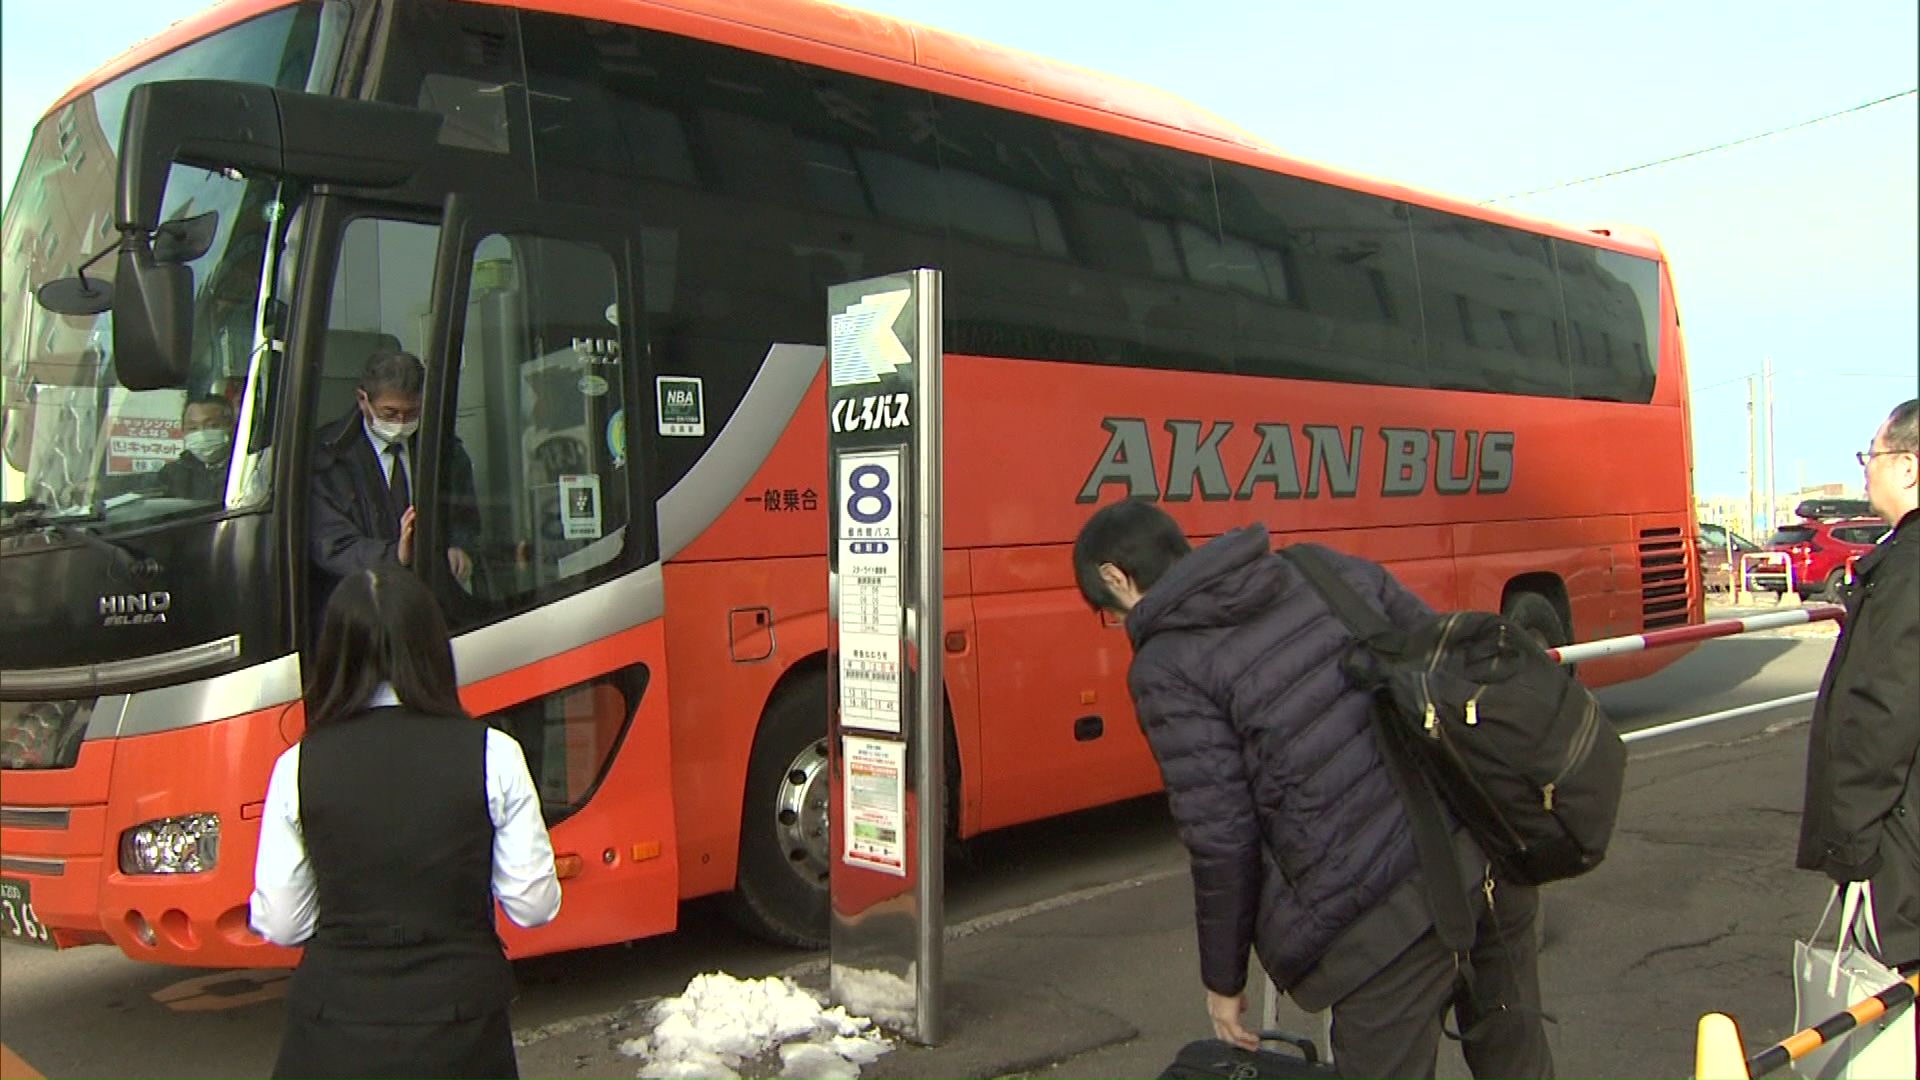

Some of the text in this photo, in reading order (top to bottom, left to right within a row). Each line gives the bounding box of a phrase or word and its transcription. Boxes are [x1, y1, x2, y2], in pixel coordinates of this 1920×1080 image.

[666, 390, 694, 406] NBA
[831, 393, 911, 433] くしろバス
[1076, 417, 1515, 502] AKAN BUS
[745, 488, 818, 512] 一般乗合
[847, 464, 892, 524] 8
[99, 591, 170, 615] HINO
